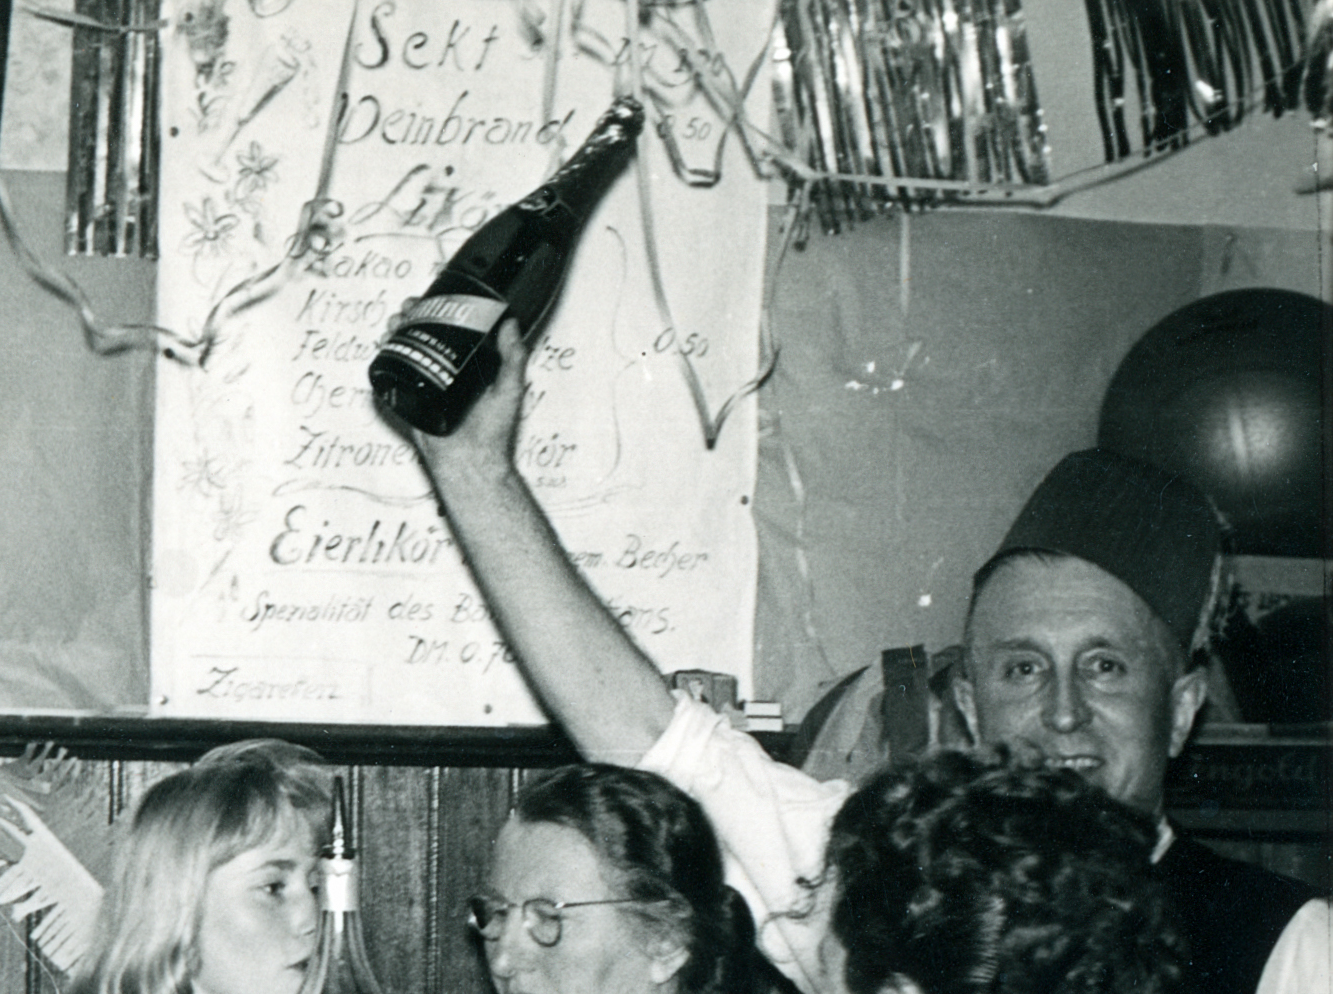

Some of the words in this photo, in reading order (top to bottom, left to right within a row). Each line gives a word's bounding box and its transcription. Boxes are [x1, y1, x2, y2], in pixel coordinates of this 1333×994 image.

[354, 2, 499, 70] Sekt
[269, 505, 455, 566] Eierlikör
[616, 534, 709, 578] Becher
[240, 590, 376, 632] Spezialität
[387, 593, 433, 621] des
